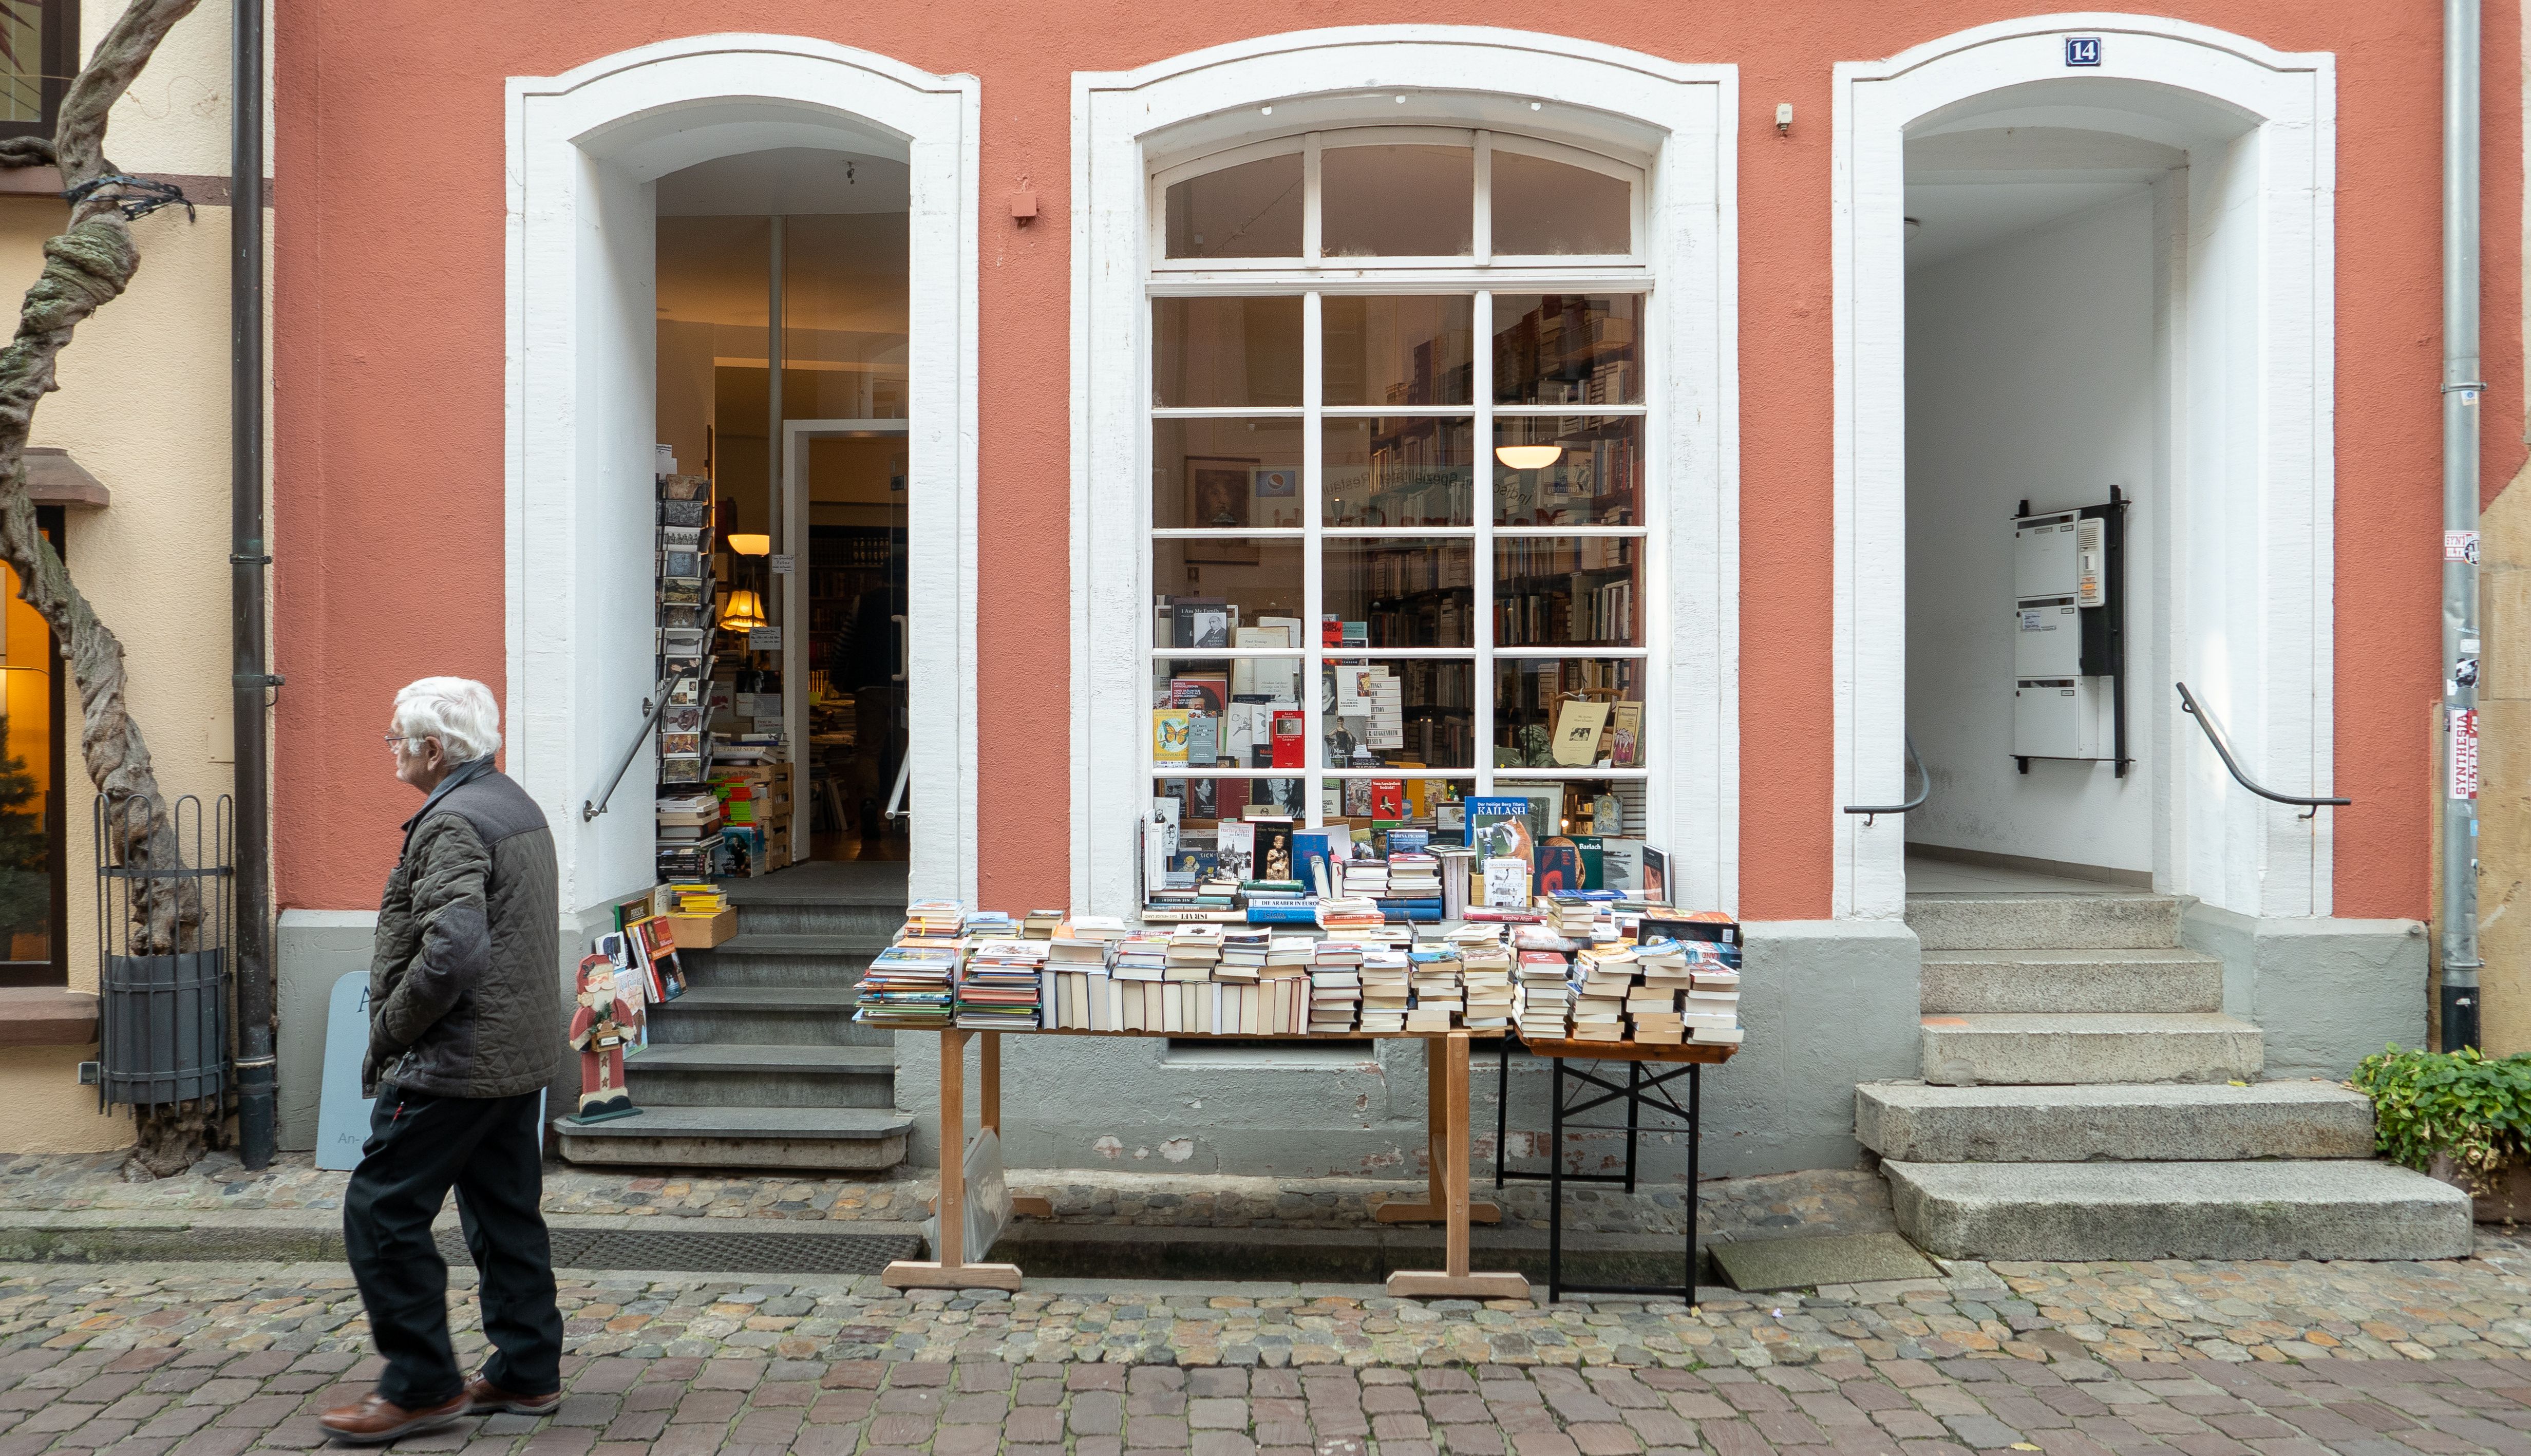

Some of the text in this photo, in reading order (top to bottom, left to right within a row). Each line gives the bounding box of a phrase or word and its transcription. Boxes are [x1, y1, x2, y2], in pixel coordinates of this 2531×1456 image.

[2072, 41, 2095, 60] 14
[2456, 714, 2467, 795] SYNTHESIA
[2469, 738, 2478, 792] ULTRAS
